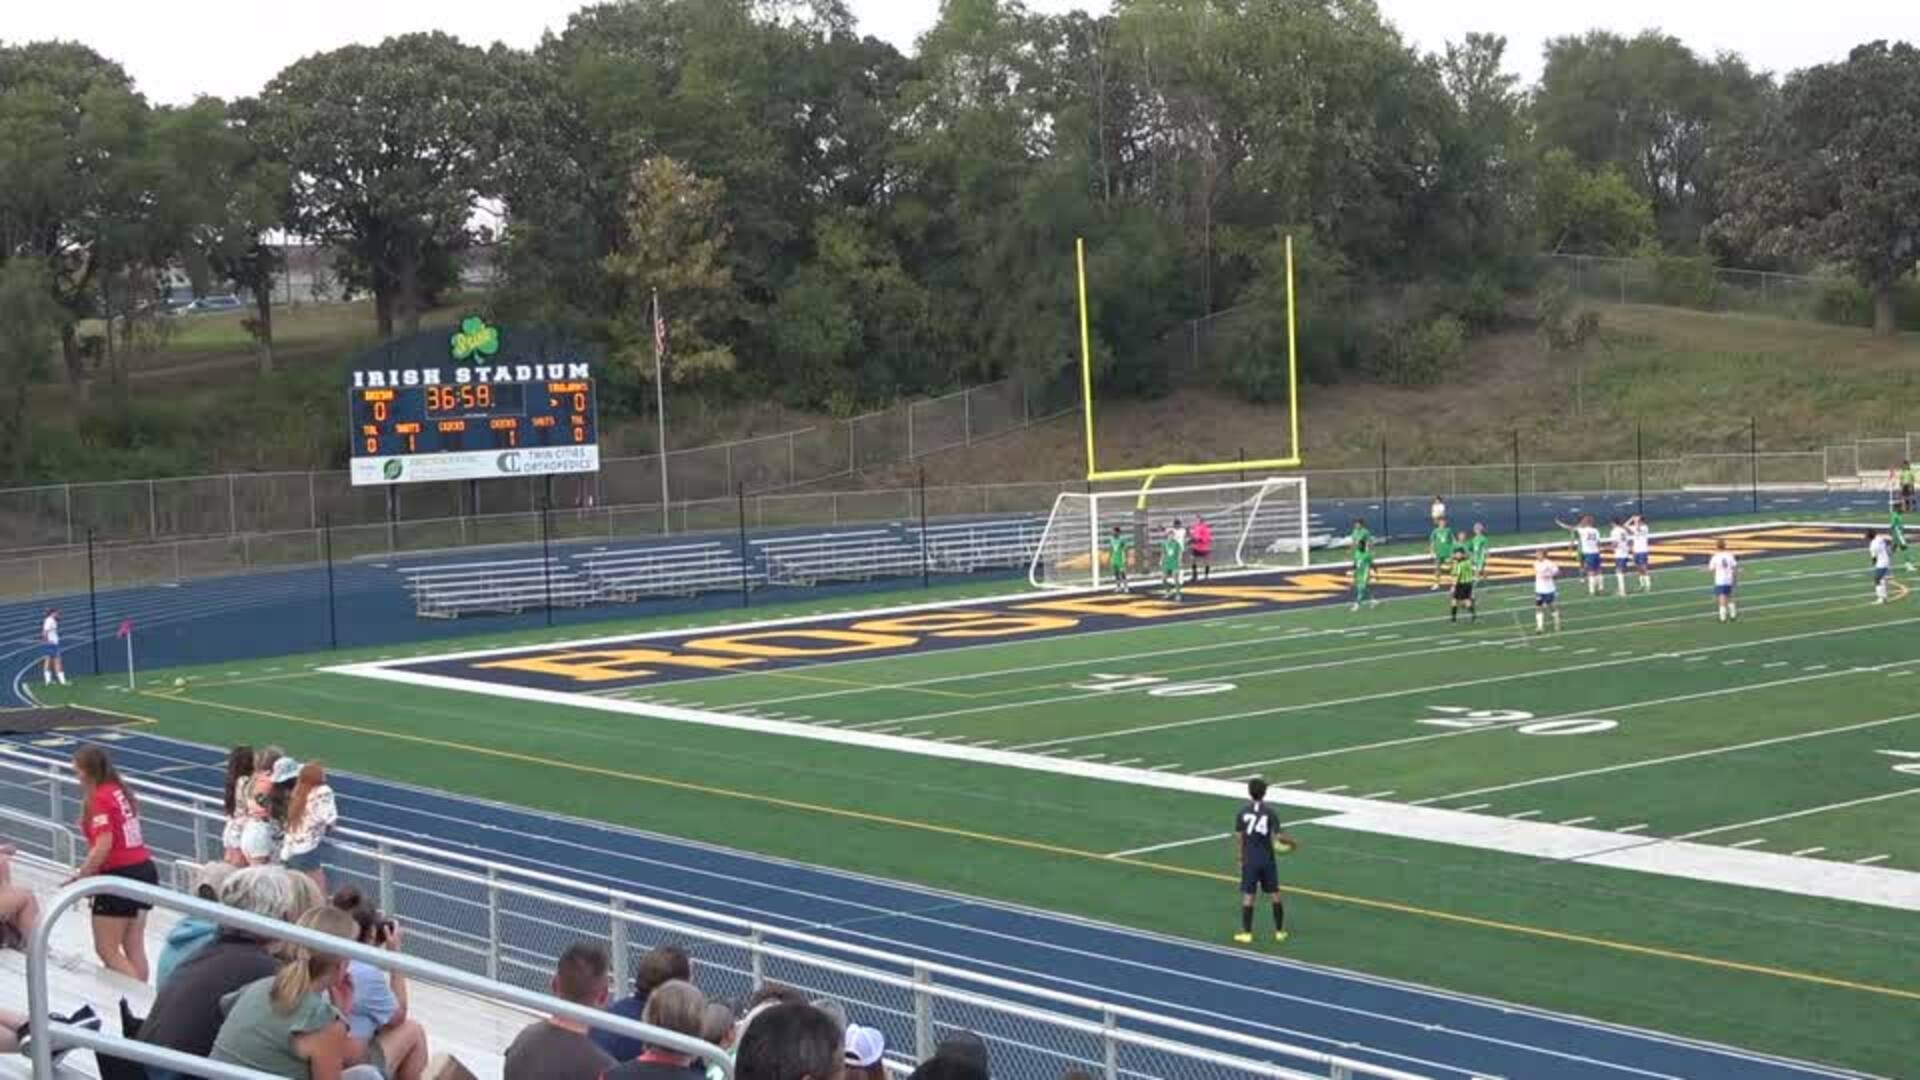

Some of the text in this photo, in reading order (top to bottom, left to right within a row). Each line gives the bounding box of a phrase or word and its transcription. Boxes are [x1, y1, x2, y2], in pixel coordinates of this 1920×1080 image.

[352, 364, 590, 387] IRISH STADIUM
[575, 392, 585, 412] 0
[374, 401, 386, 421] 0
[509, 430, 515, 446] 1
[574, 427, 583, 441] 0
[367, 438, 378, 452] 0
[409, 435, 415, 452] 1
[527, 447, 586, 459] TWIN CITIES
[523, 459, 591, 472] ORTHOPEDICS
[1242, 813, 1269, 836] 74
